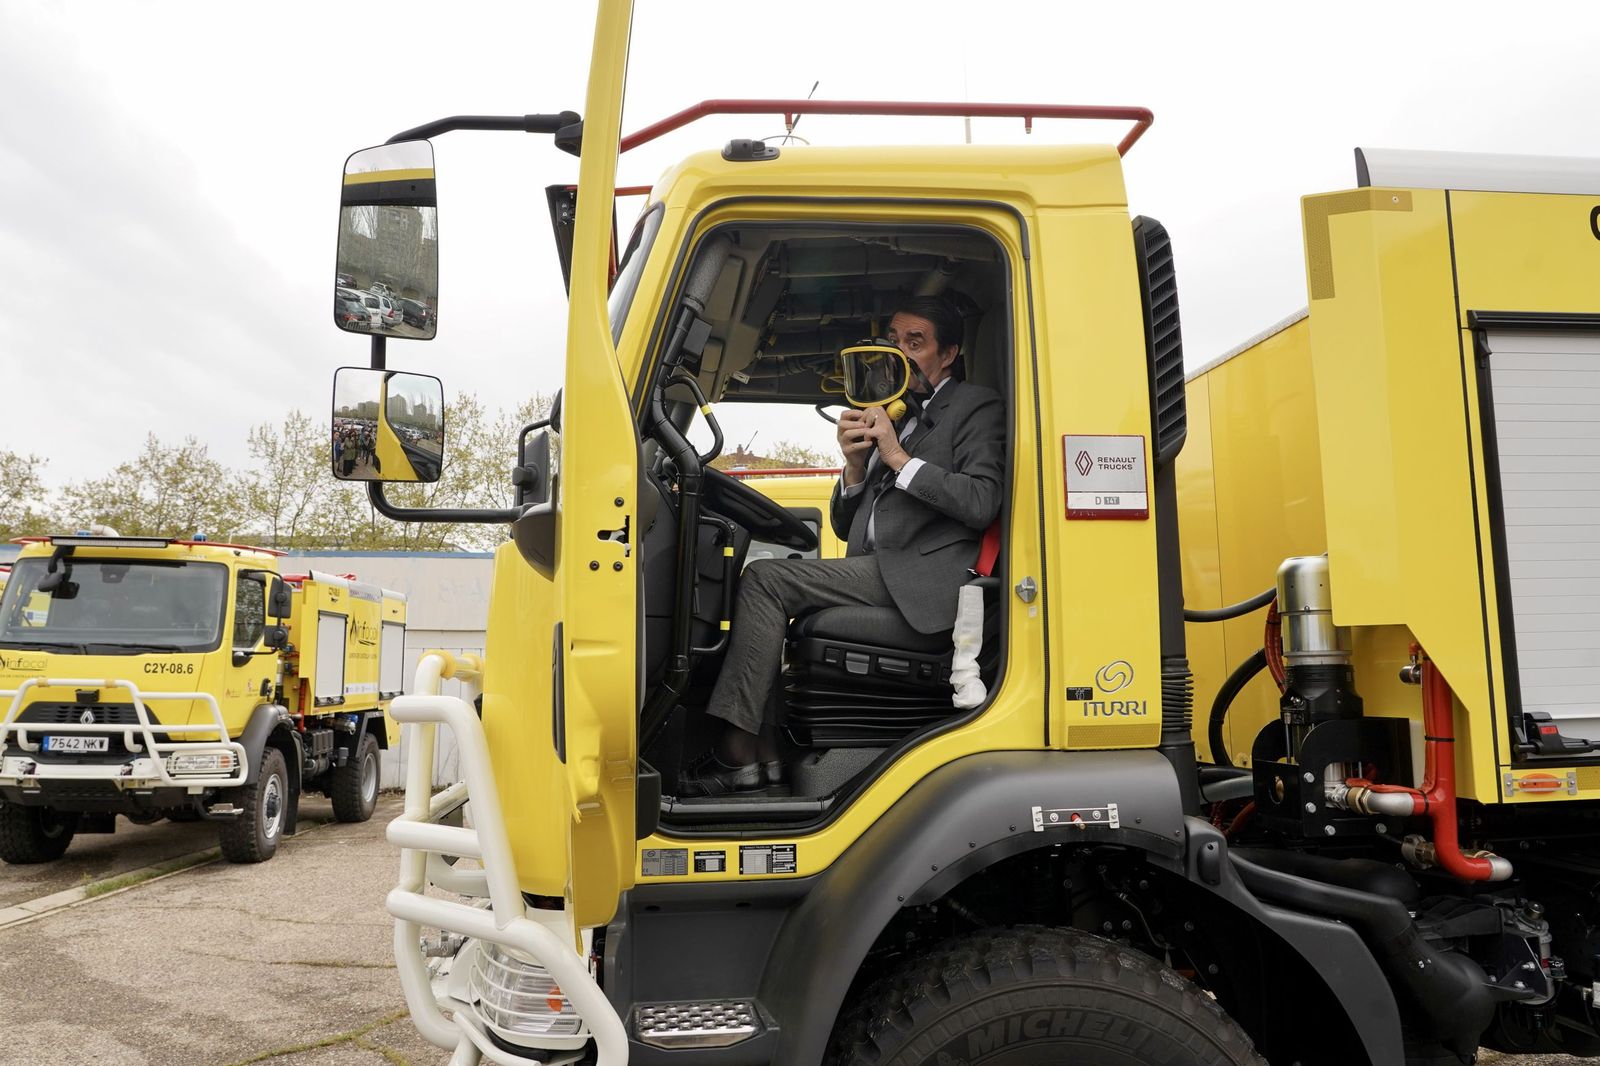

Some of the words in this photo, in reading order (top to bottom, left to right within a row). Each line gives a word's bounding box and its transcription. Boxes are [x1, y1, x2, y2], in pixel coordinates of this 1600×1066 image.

[1098, 463, 1133, 471] TRUCKS
[1095, 496, 1102, 505] D
[144, 662, 194, 674] C2Y-08.6
[1083, 701, 1147, 717] ITURRI
[51, 738, 80, 749] 7542
[967, 1008, 1187, 1066] MICHELIN
